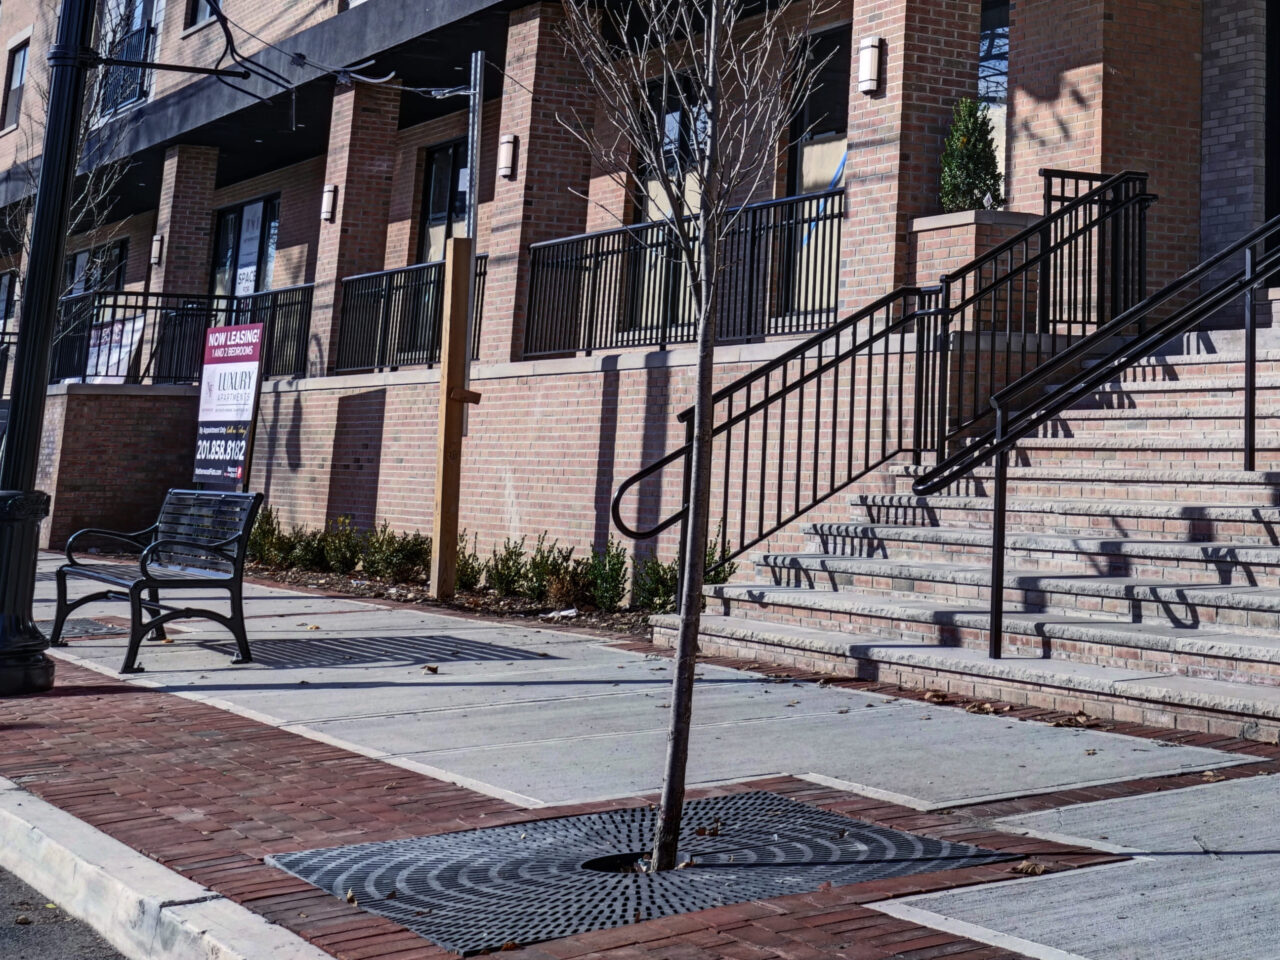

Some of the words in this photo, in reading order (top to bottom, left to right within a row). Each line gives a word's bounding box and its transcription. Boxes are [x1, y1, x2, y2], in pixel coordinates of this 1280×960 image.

[209, 332, 226, 346] NOW
[227, 329, 260, 345] LEASING!
[214, 348, 225, 357] AND
[228, 345, 254, 357] BEDROOMS
[218, 371, 254, 391] LUXURY
[196, 440, 246, 460] 201.858.8182
